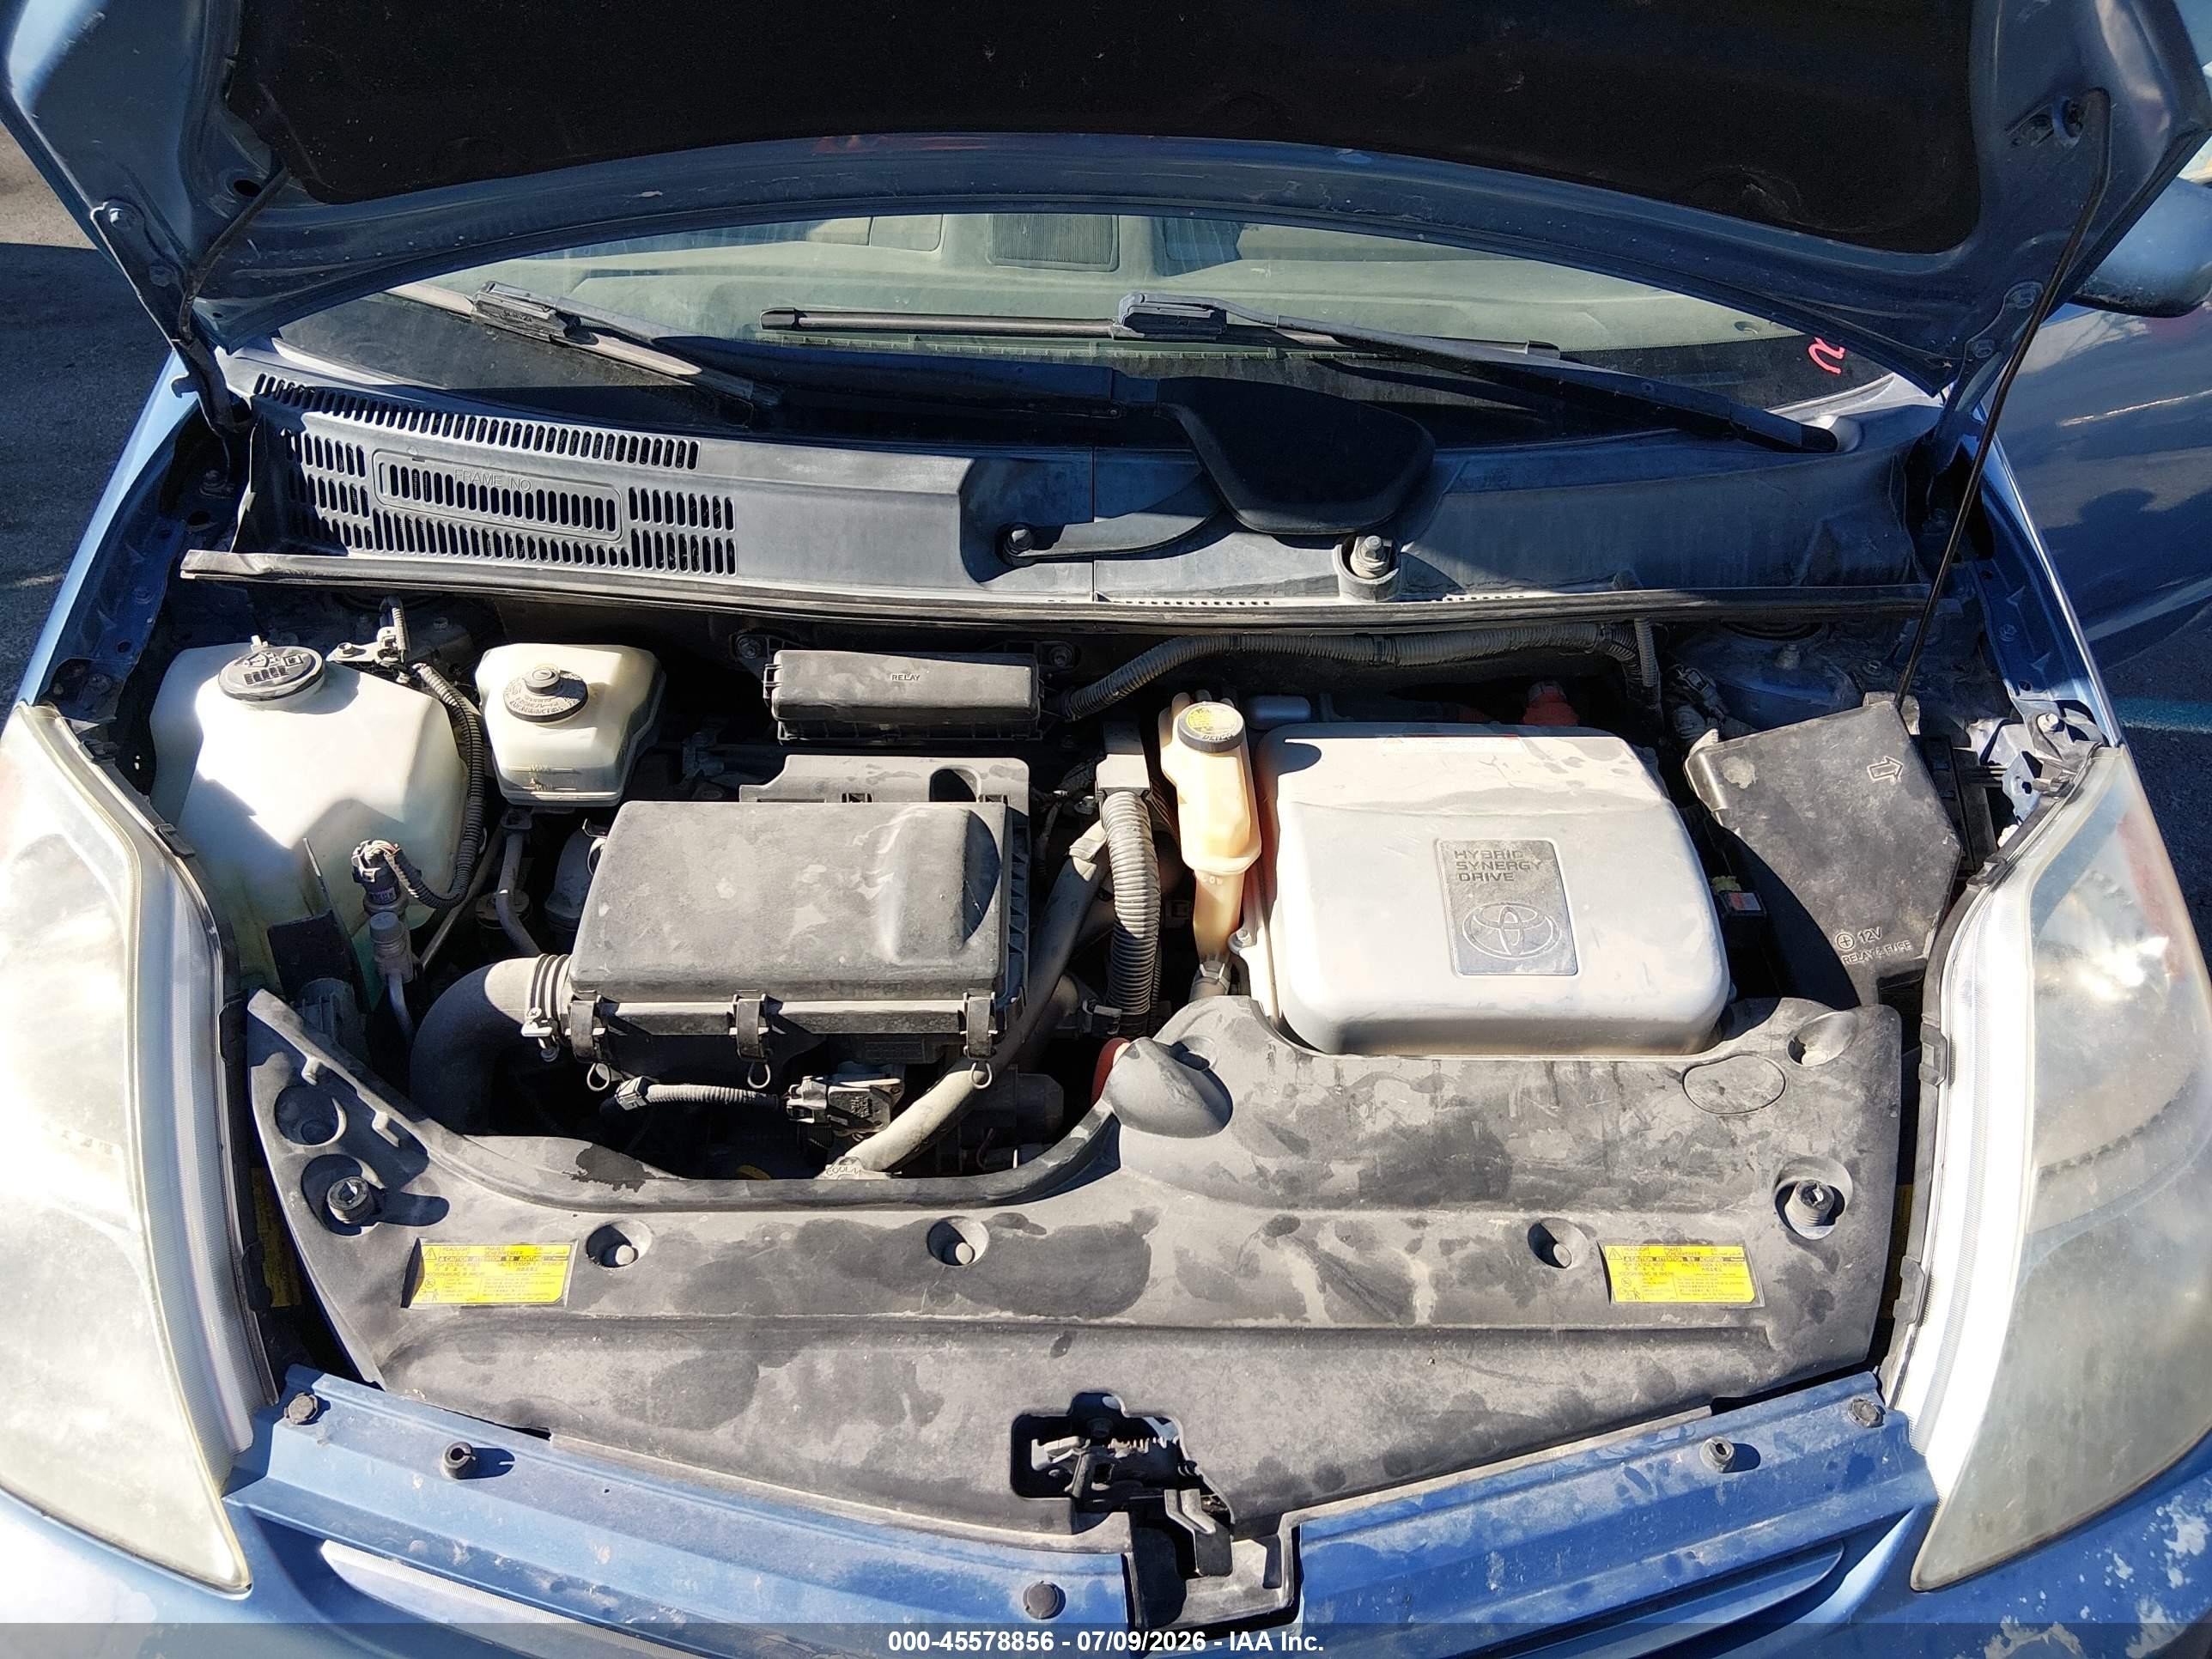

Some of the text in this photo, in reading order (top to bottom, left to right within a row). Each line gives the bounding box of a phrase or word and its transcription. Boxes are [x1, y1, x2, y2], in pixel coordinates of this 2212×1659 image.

[454, 468, 533, 493] FRAME NO.
[1454, 850, 1524, 860] HYBRID
[1455, 860, 1542, 872] SYNERGY
[1458, 872, 1515, 882] DRIVE
[1858, 927, 1882, 943] 12V
[1843, 940, 1911, 964] RELAY & FUSE
